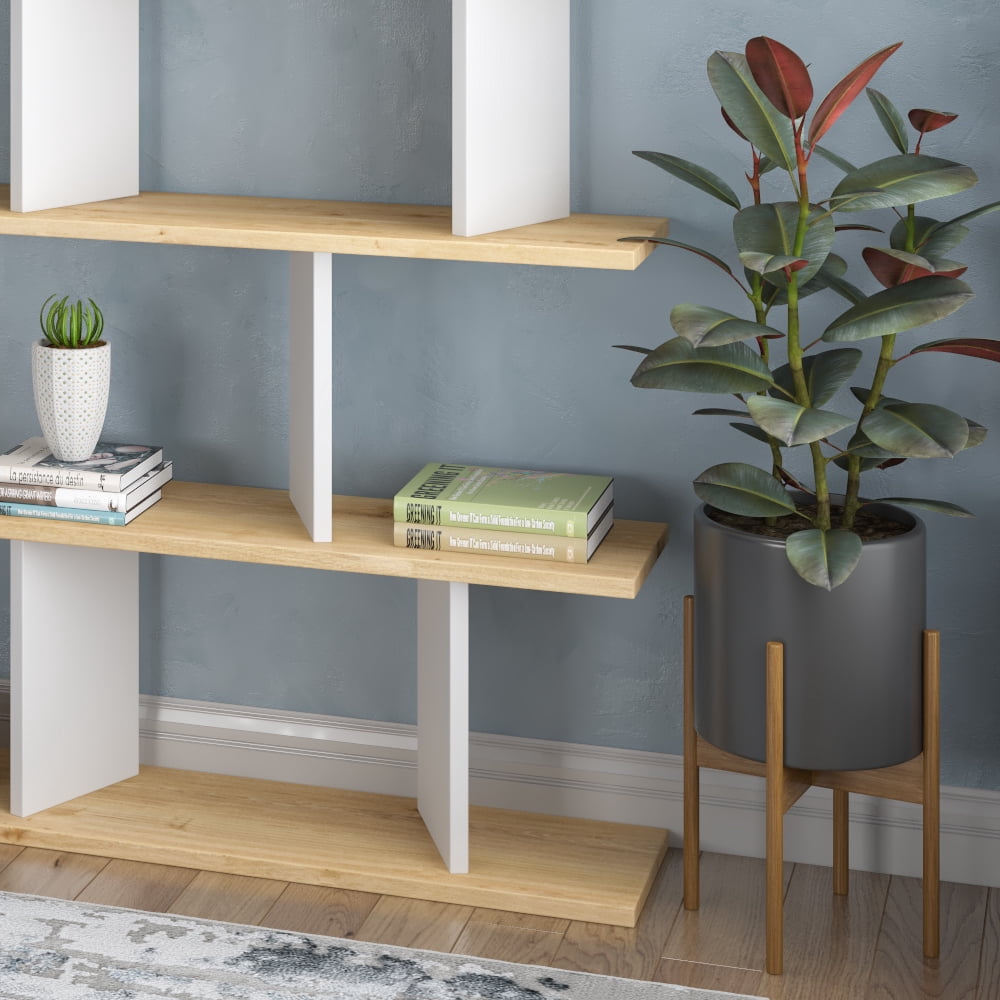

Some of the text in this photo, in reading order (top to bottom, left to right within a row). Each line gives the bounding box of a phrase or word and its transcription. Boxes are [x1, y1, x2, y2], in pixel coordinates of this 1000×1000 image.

[18, 469, 54, 485] persistance
[410, 471, 459, 499] GREENING
[406, 503, 442, 526] GREENING IT
[406, 528, 442, 551] GREENING IT
